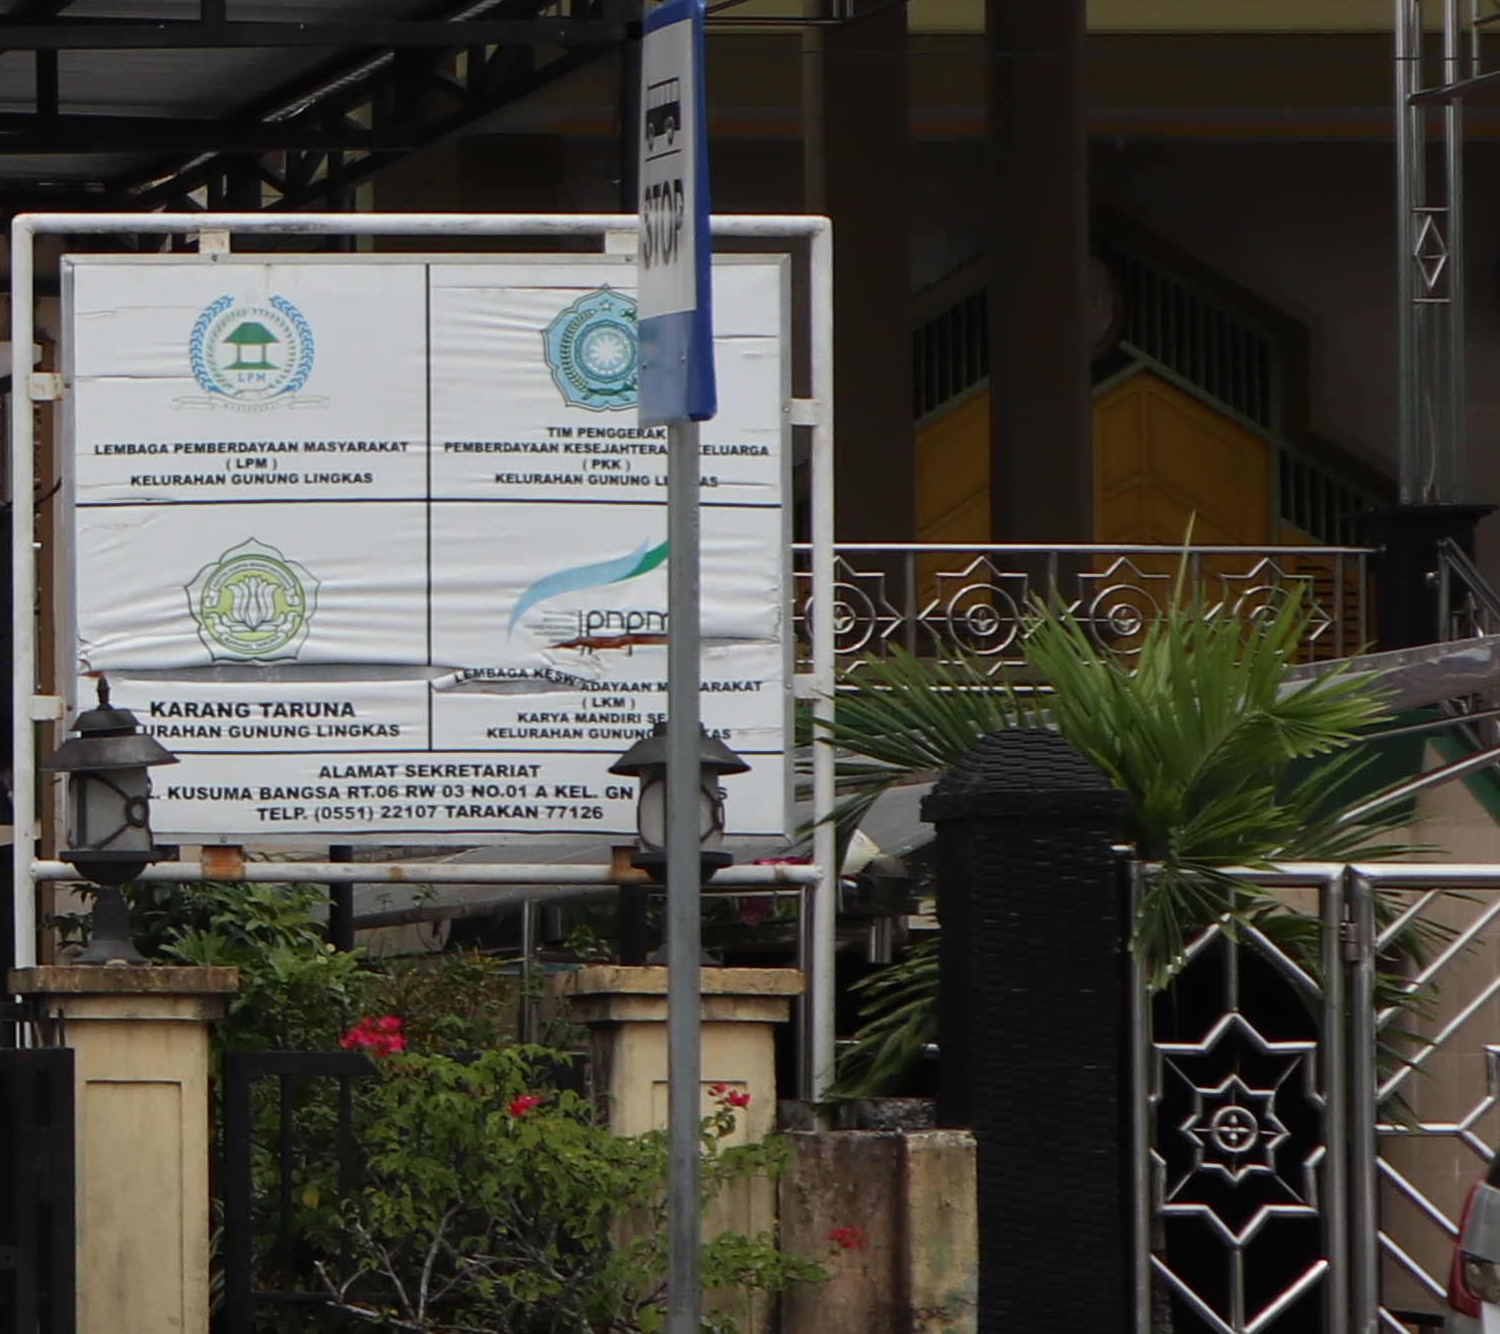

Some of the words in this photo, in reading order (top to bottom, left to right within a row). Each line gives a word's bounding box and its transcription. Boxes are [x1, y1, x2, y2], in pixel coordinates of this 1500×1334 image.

[643, 178, 684, 271] STOP
[547, 427, 573, 438] TIM
[577, 427, 666, 440] PENGGERAK
[94, 444, 169, 455] LEMBAGA
[174, 442, 299, 453] PEMBERDAYAAN
[304, 441, 409, 453] MASYARAKAT
[131, 474, 226, 486] KELURAHAN
[231, 473, 299, 484] GUNUNG
[304, 473, 373, 484] LINGKAS
[150, 703, 250, 719] KARANG
[256, 702, 356, 719] TARUNA
[228, 724, 312, 739] GUNUNG
[316, 723, 400, 738] LINGKAS
[318, 764, 400, 779] ALAMAT
[404, 764, 540, 779] SEKRETARIAT
[168, 785, 252, 801] KUSUMA
[260, 785, 340, 801] BANGSA
[348, 785, 398, 801] RT.06
[406, 785, 436, 800] RW
[442, 785, 464, 800] 03
[472, 785, 528, 799] NO.01
[535, 785, 548, 799] A
[554, 785, 597, 799] KEL.
[606, 785, 634, 800] GN
[256, 805, 309, 821] TELP.
[314, 803, 374, 823] (0551)
[380, 804, 438, 820] 22107
[444, 804, 538, 820] TARAKAN
[544, 804, 604, 820] 77126
